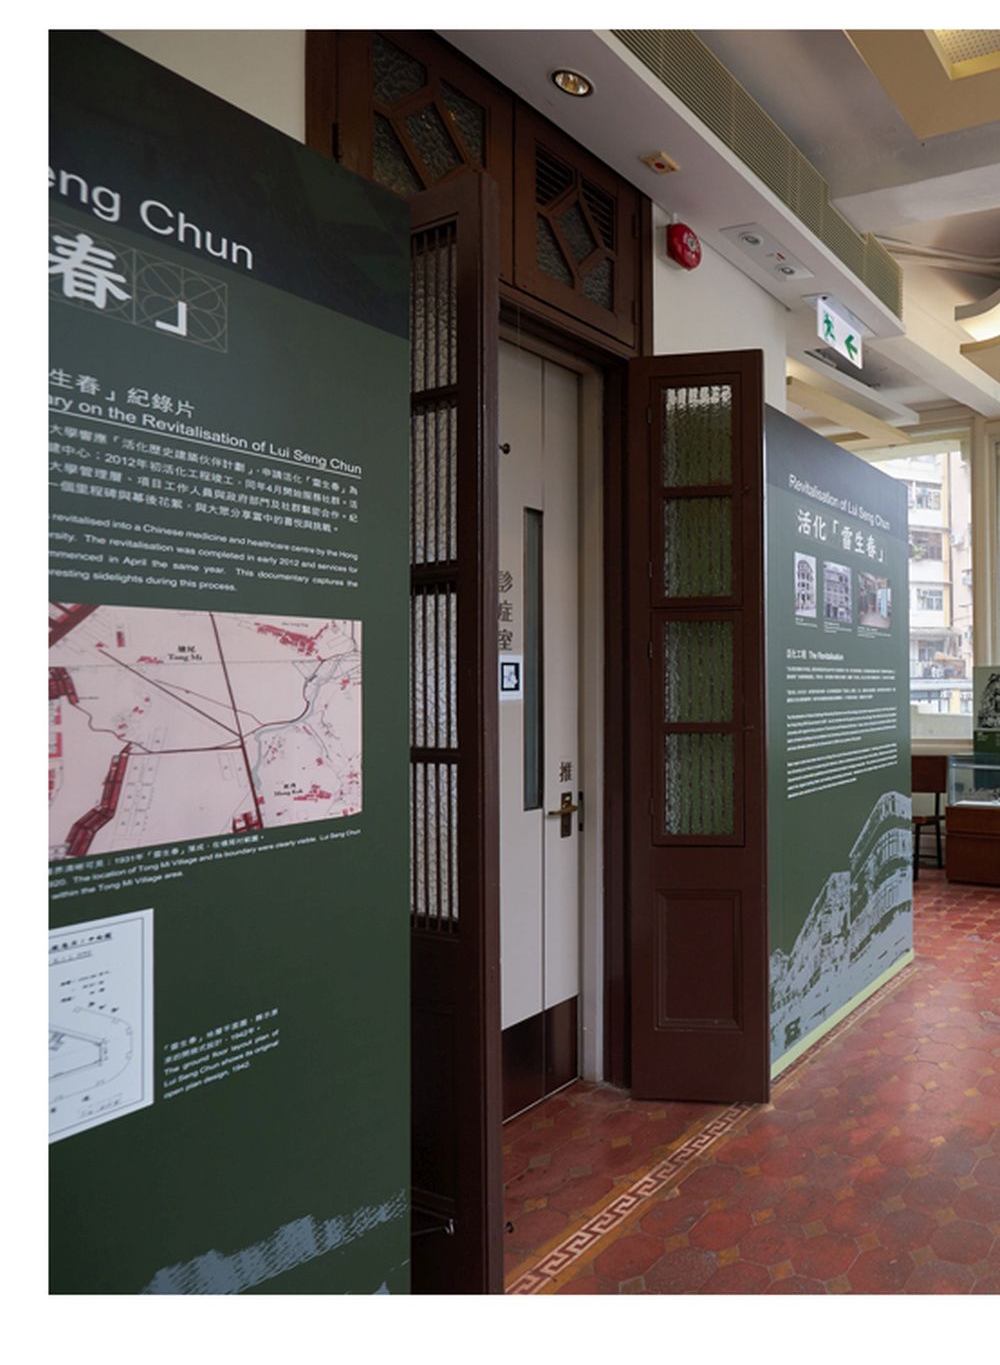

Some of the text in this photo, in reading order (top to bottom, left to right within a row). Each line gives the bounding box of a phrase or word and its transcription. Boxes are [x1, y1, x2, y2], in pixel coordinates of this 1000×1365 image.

[48, 166, 254, 270] ng Chun
[78, 402, 103, 416] on
[108, 406, 137, 424] the
[142, 413, 248, 449] Revitalisation
[252, 441, 267, 453] of
[269, 443, 290, 458] Lui
[293, 449, 328, 469] Seng
[330, 458, 362, 475] Chun
[788, 473, 841, 508] Revitalisation
[847, 500, 858, 516] Lui
[859, 506, 875, 527] Seng
[875, 514, 890, 530] Chun
[52, 513, 110, 528] revitalised
[112, 520, 132, 531] into
[134, 524, 141, 532] a
[143, 523, 184, 537] Chinese
[186, 530, 228, 543] medicine
[229, 535, 246, 546] and
[247, 538, 290, 551] healthcare
[316, 546, 325, 556] by
[326, 548, 338, 558] the
[339, 551, 359, 562] Hong
[84, 533, 107, 545] The
[109, 537, 174, 553] revitalisation
[176, 546, 196, 556] was
[198, 548, 245, 562] completed
[247, 552, 255, 562] in
[257, 555, 278, 567] early
[279, 557, 299, 568] 2012
[301, 560, 316, 569] and
[317, 562, 347, 573] services
[348, 565, 358, 574] for
[93, 571, 143, 585] sidelights
[145, 575, 177, 588] during
[179, 577, 196, 589] this
[198, 581, 237, 592] process.
[109, 554, 119, 564] in
[122, 556, 147, 567] April
[151, 558, 168, 569] the
[172, 563, 199, 572] same
[235, 567, 254, 578] This
[257, 570, 309, 584] documentary
[312, 575, 344, 587] captures
[347, 579, 358, 588] the
[559, 760, 573, 783] 推
[92, 869, 126, 881] location
[172, 855, 197, 867] Village
[51, 888, 80, 901] within
[80, 885, 97, 896] the
[98, 881, 121, 892] Tong
[134, 873, 163, 885] Village
[182, 1054, 210, 1071] ground
